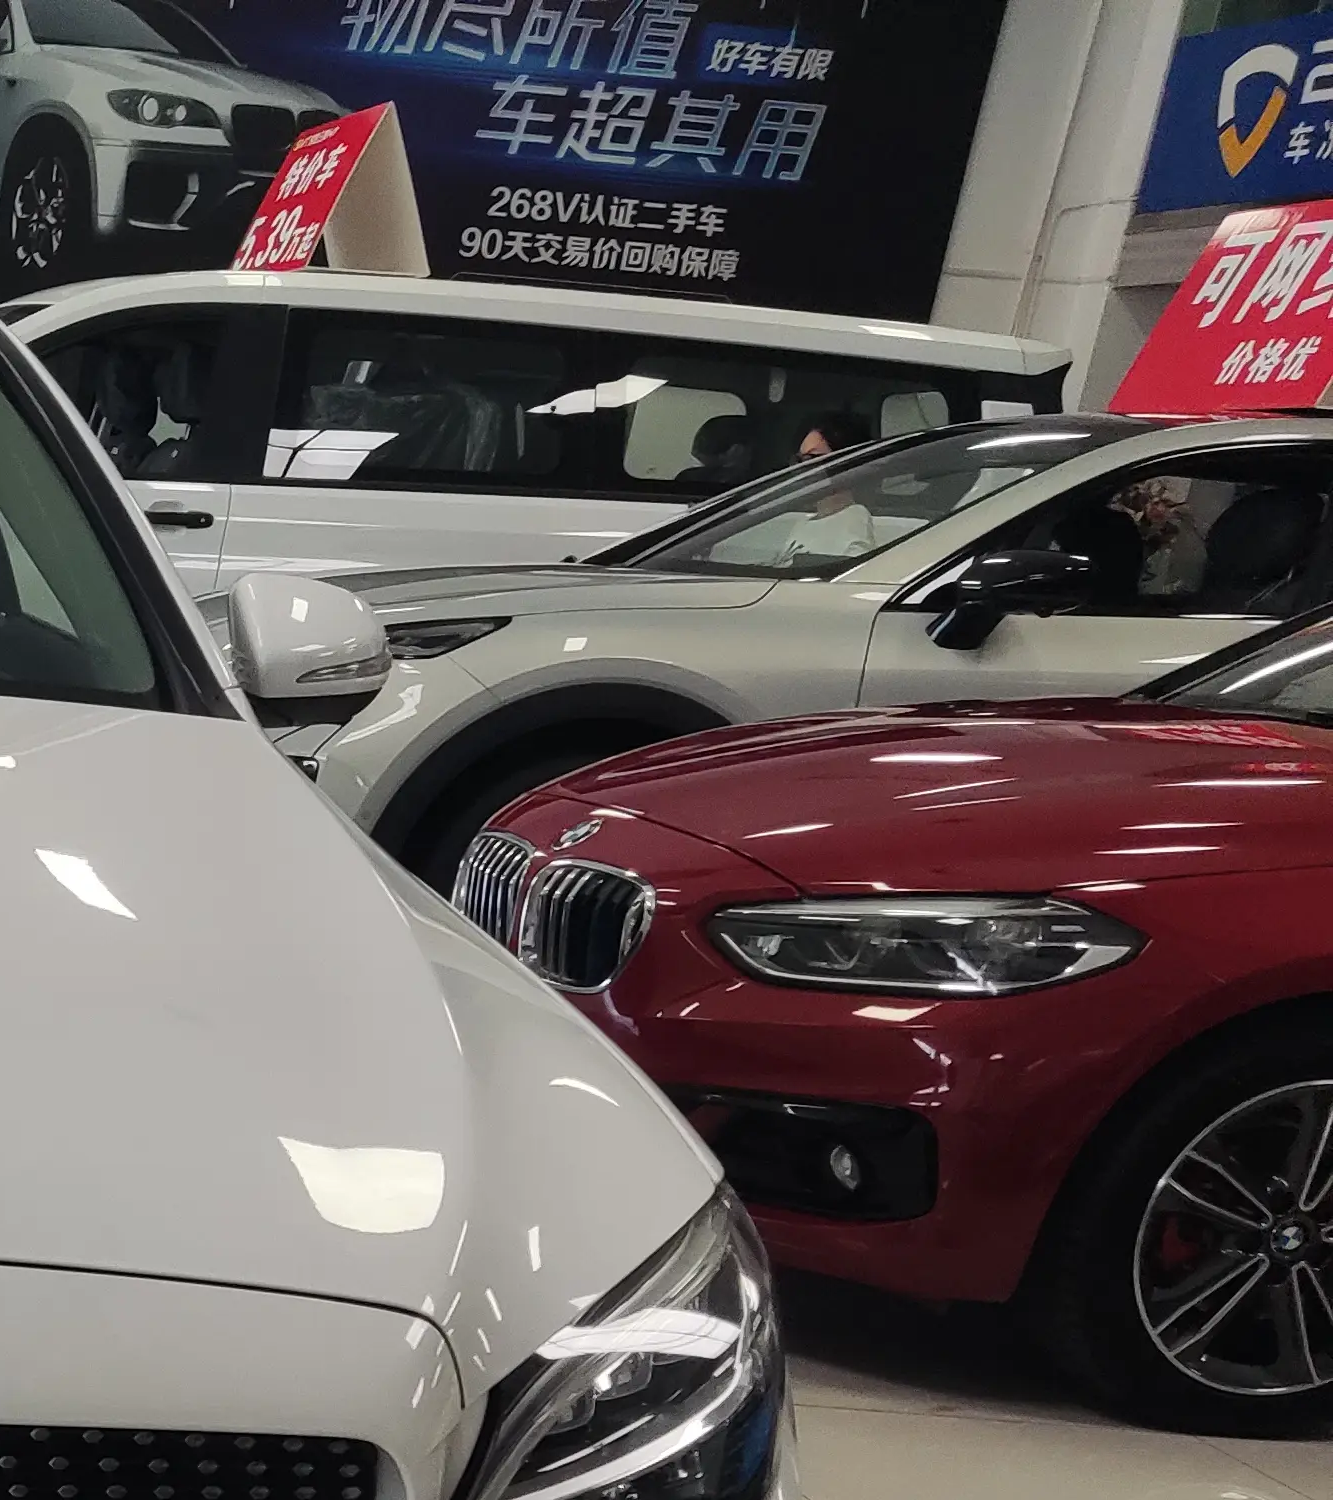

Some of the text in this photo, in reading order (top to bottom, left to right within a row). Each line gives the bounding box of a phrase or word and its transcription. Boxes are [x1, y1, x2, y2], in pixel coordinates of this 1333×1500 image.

[705, 38, 834, 82] 好车有限
[474, 74, 827, 183] 车超其用
[275, 142, 349, 202] 特价车
[486, 185, 729, 238] 268V认证二手车
[458, 225, 742, 282] 90天交易价回购保障
[1214, 336, 1322, 386] 价格优
